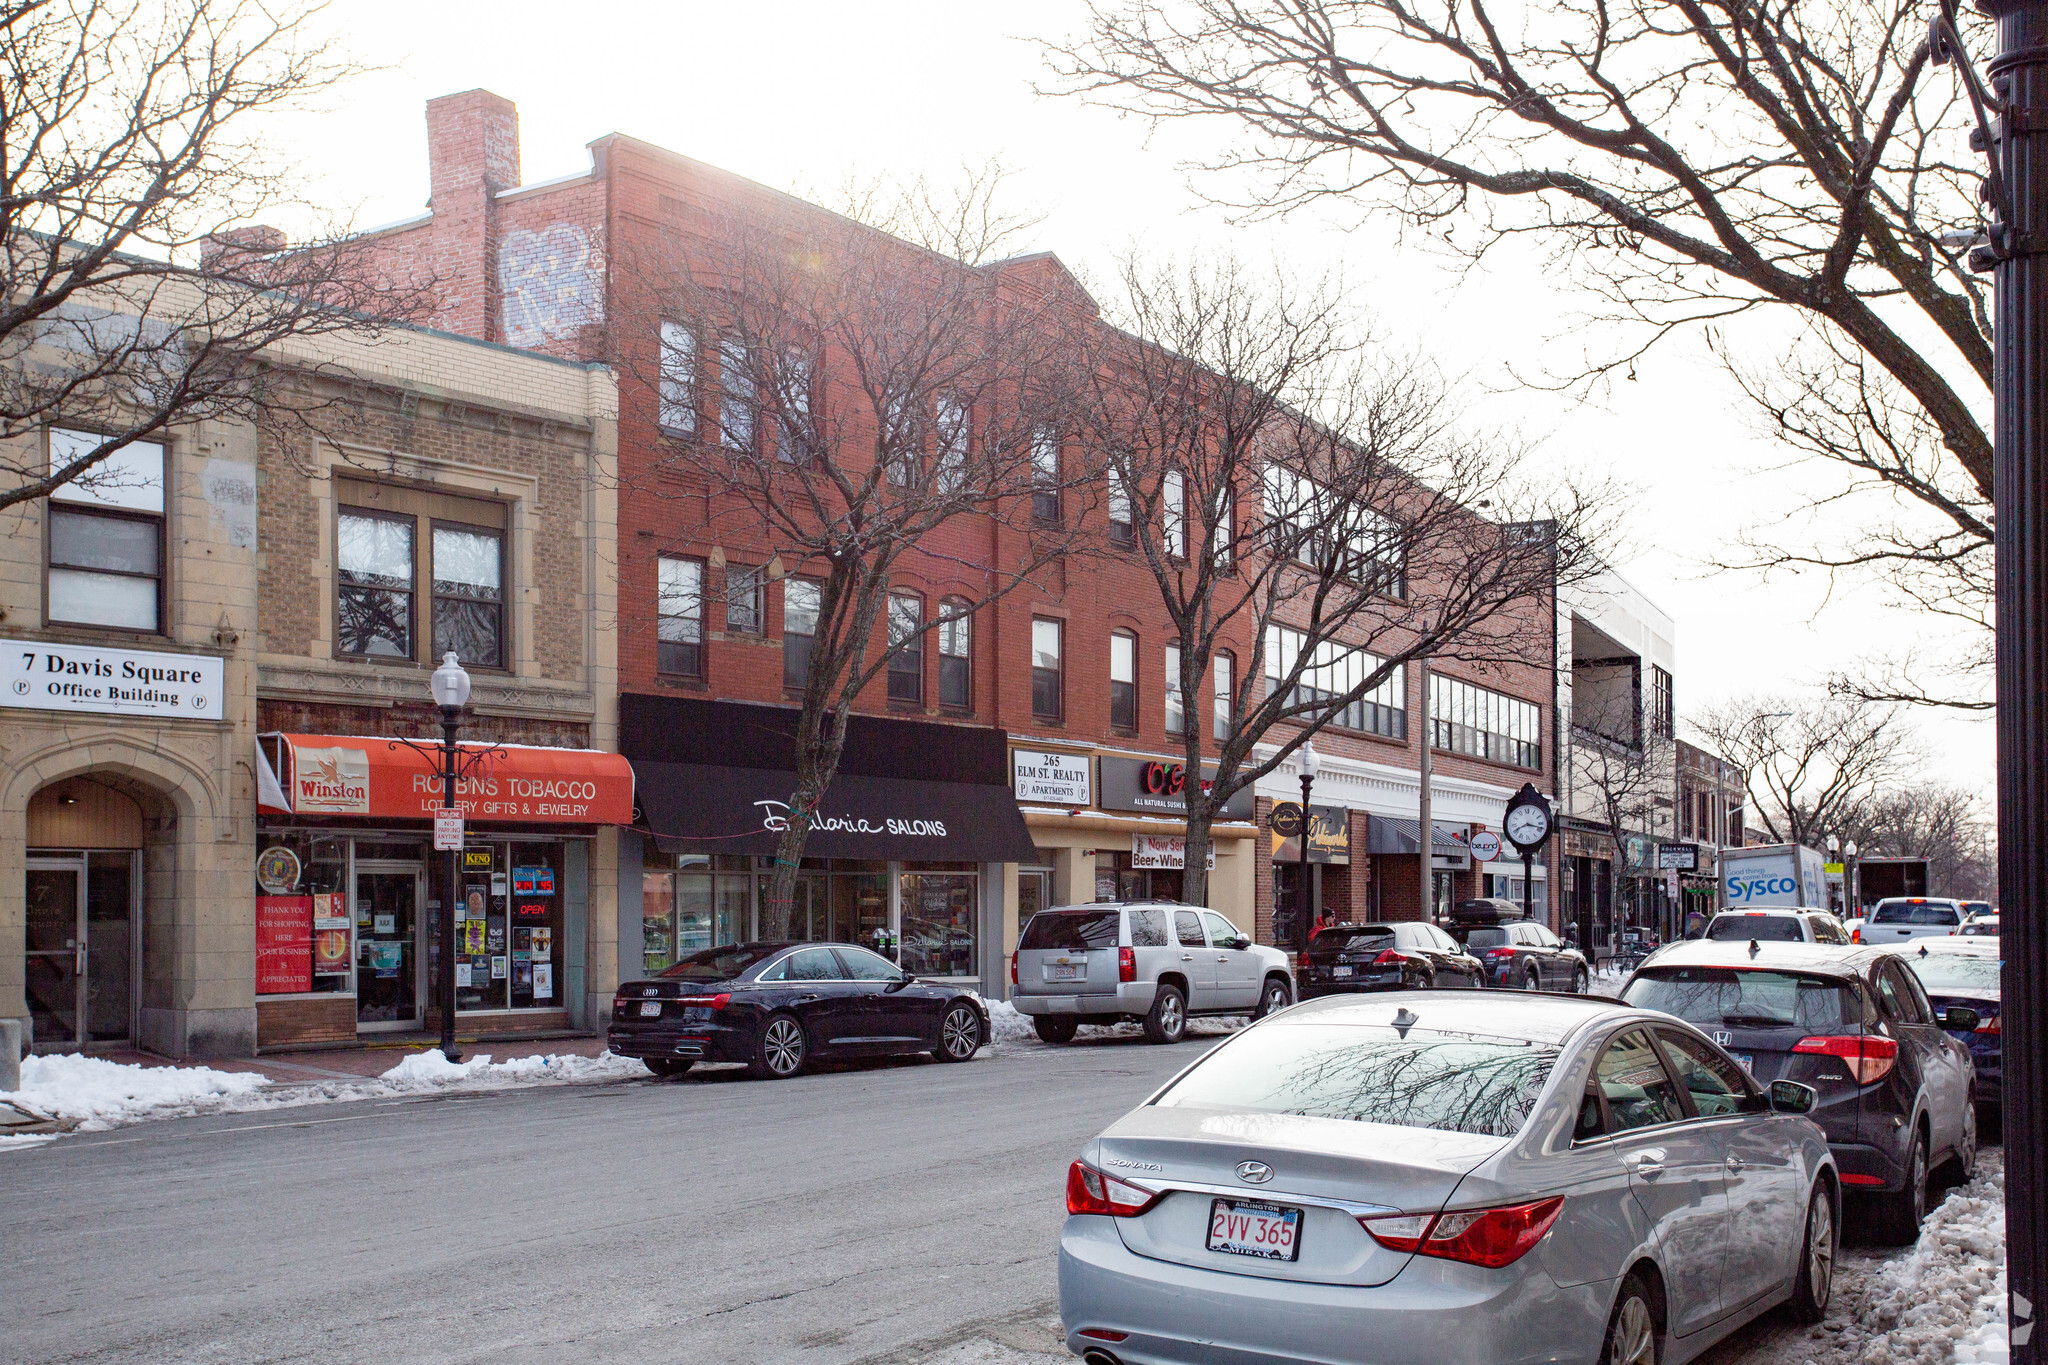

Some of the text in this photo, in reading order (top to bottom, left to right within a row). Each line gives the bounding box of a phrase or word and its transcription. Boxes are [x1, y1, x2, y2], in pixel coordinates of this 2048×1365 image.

[22, 653, 202, 685] 7 Davis Square
[47, 682, 180, 706] Office Building
[1043, 754, 1060, 767] 265
[1017, 765, 1085, 782] ELM ST. REALTY
[300, 780, 366, 799] Winston
[412, 773, 597, 800] ROBINS TOBACCO
[1031, 785, 1074, 797] APARTMENTS
[421, 799, 589, 816] LOTERY GIFTS & JEWELRY
[1144, 799, 1167, 807] NATURAL
[1167, 800, 1182, 809] SUSHI
[886, 818, 947, 837] SALONS
[1148, 837, 1169, 851] Now
[1471, 842, 1498, 851] beyond
[1745, 867, 1766, 875] things
[540, 880, 553, 891] 45
[263, 906, 306, 914] THANK YOU
[520, 904, 546, 915] OPEN
[259, 920, 274, 928] FOR
[274, 920, 309, 928] SHOPPING
[274, 934, 293, 942] HERE
[258, 948, 310, 956] YOUR BUSINESS
[280, 961, 288, 969] IS
[1106, 1158, 1163, 1172] SONATA
[1235, 1201, 1280, 1212] ARLINGTON
[1285, 1214, 1295, 1223] 19
[1212, 1213, 1294, 1246] 2VV 365
[1229, 1247, 1272, 1259] MIRAK
